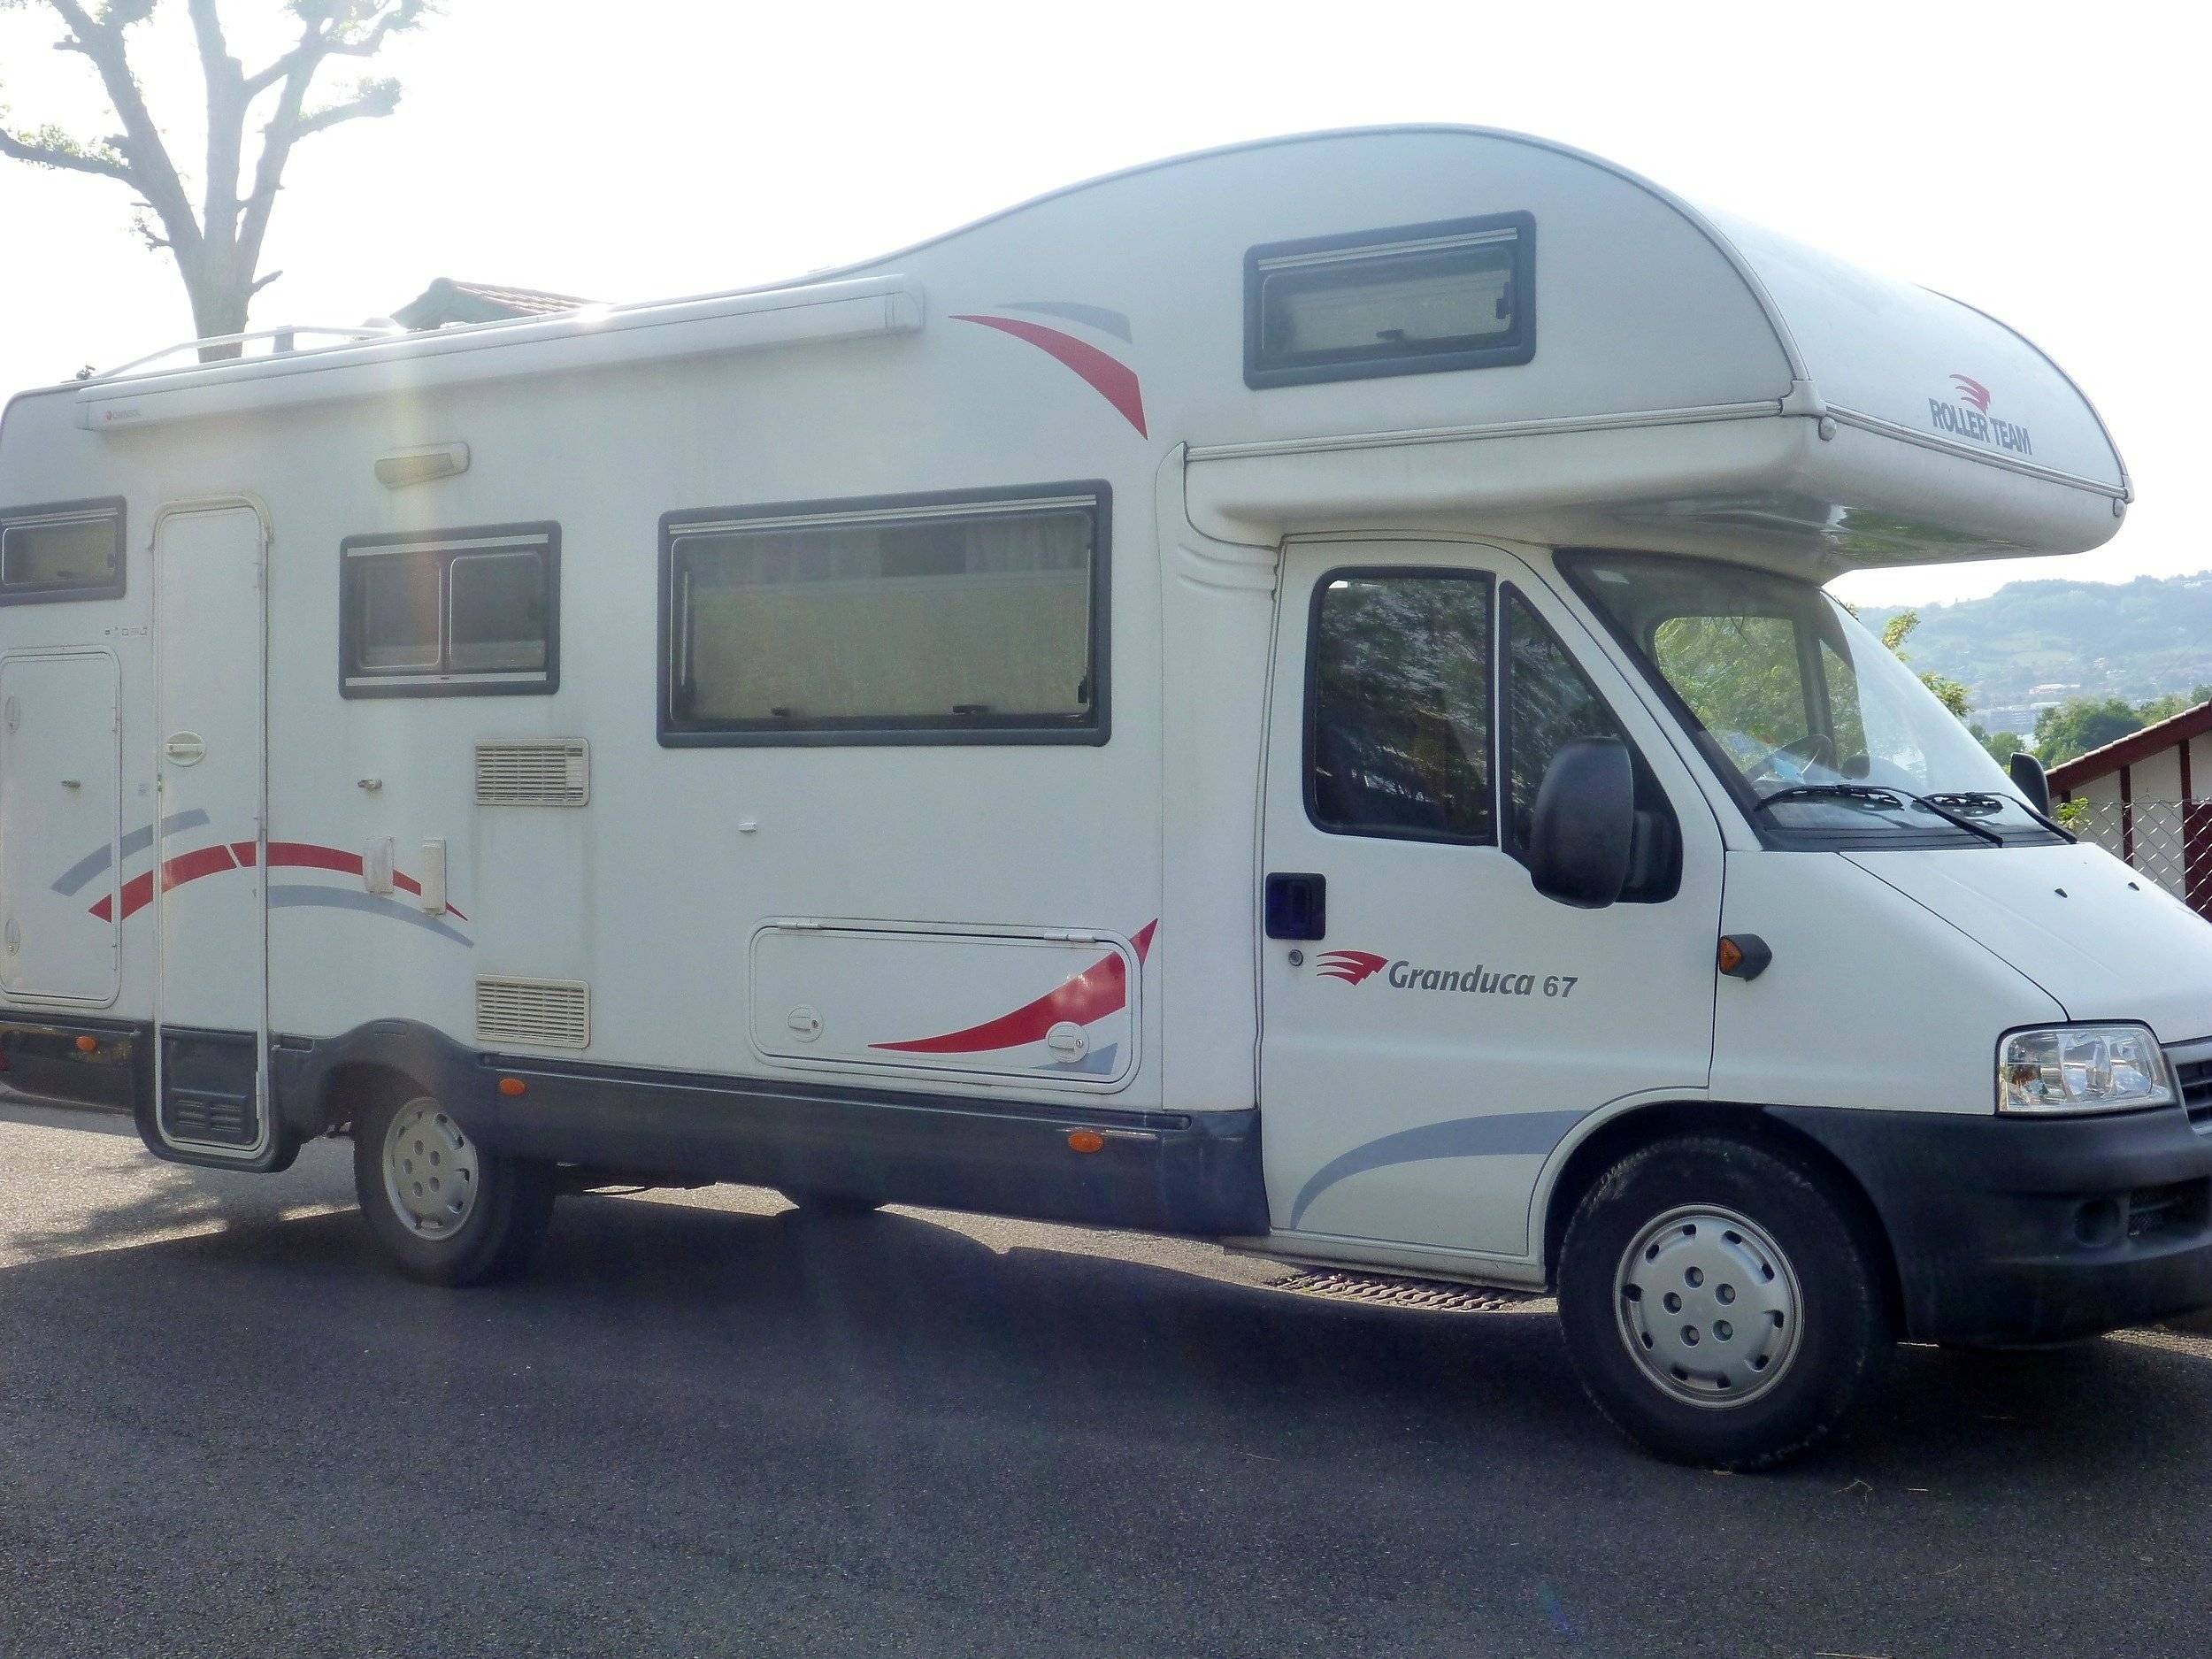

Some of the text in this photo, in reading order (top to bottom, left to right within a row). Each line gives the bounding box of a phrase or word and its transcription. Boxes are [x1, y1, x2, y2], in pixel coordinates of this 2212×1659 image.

[1929, 398, 2032, 455] ROLLER TEAM
[1389, 960, 1578, 998] Granduca 67
